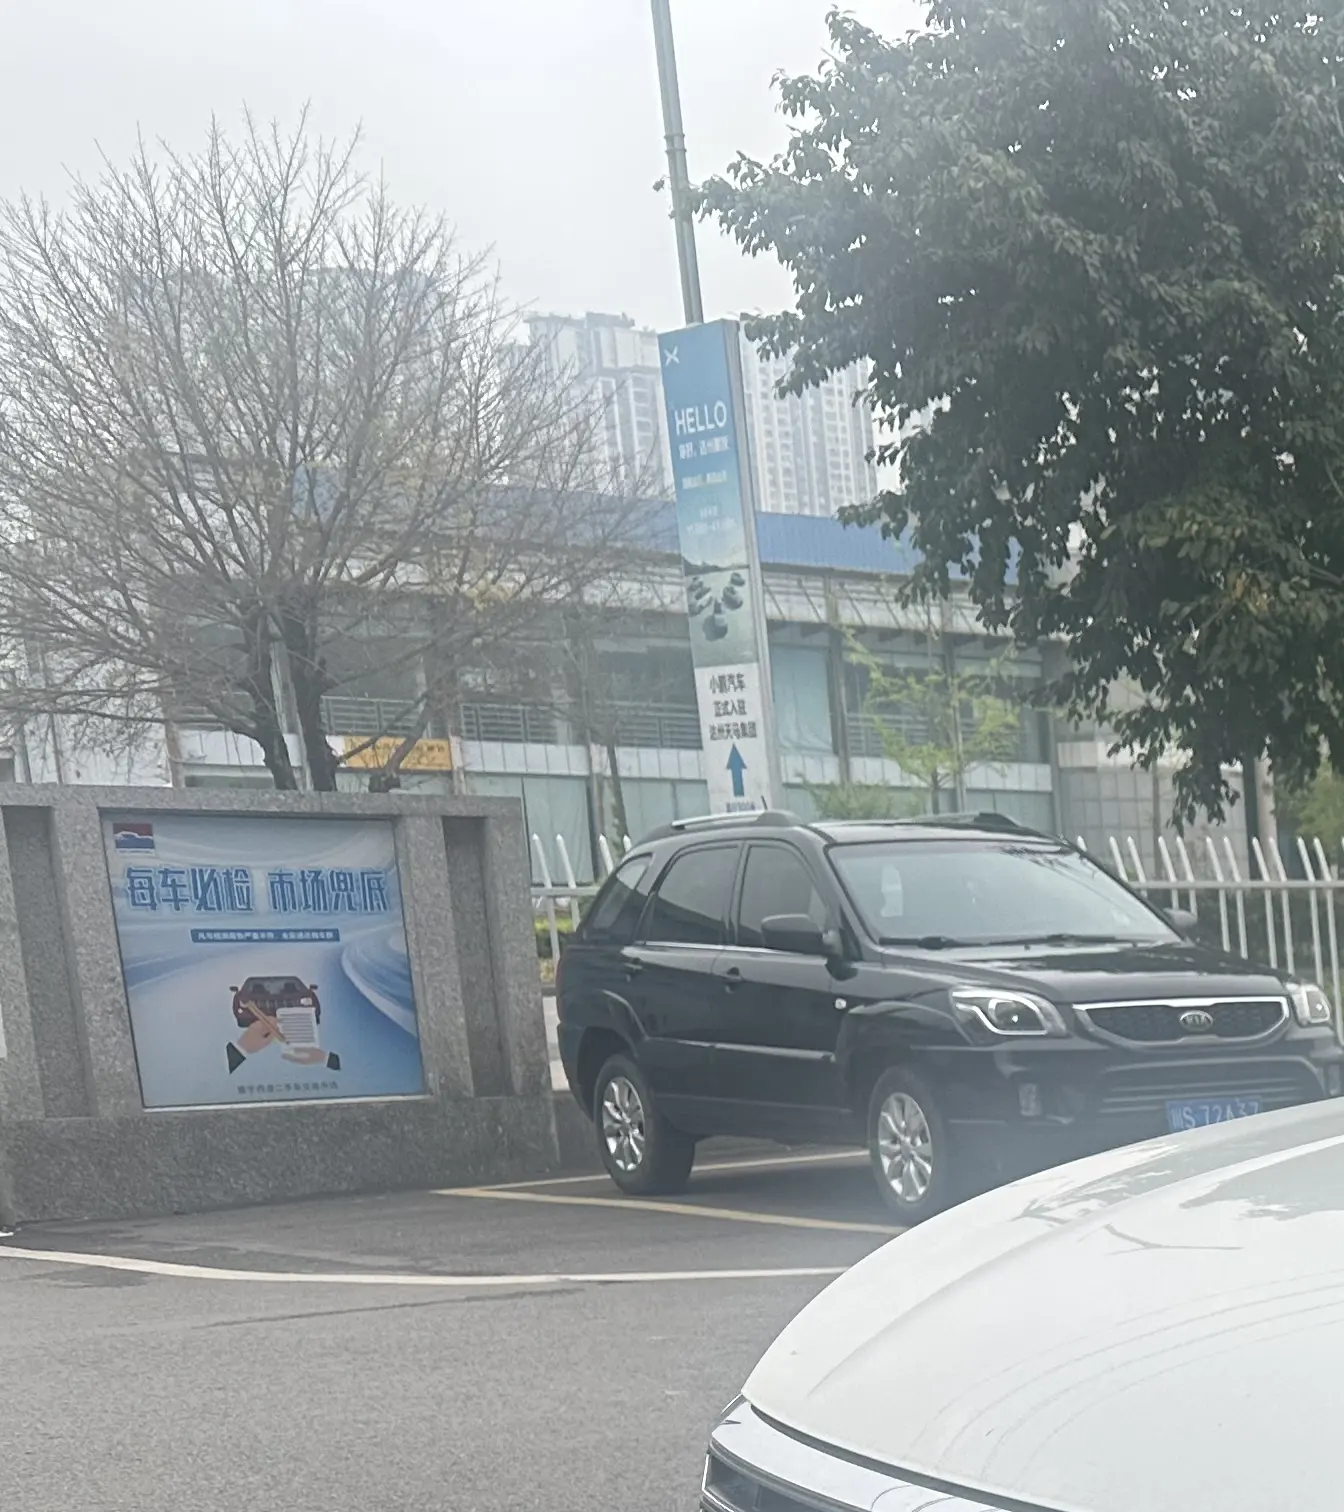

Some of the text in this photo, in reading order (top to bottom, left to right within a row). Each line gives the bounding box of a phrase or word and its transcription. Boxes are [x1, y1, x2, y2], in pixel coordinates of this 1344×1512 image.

[674, 400, 728, 436] HELLO
[126, 866, 390, 912] 每车必检 市场兜底
